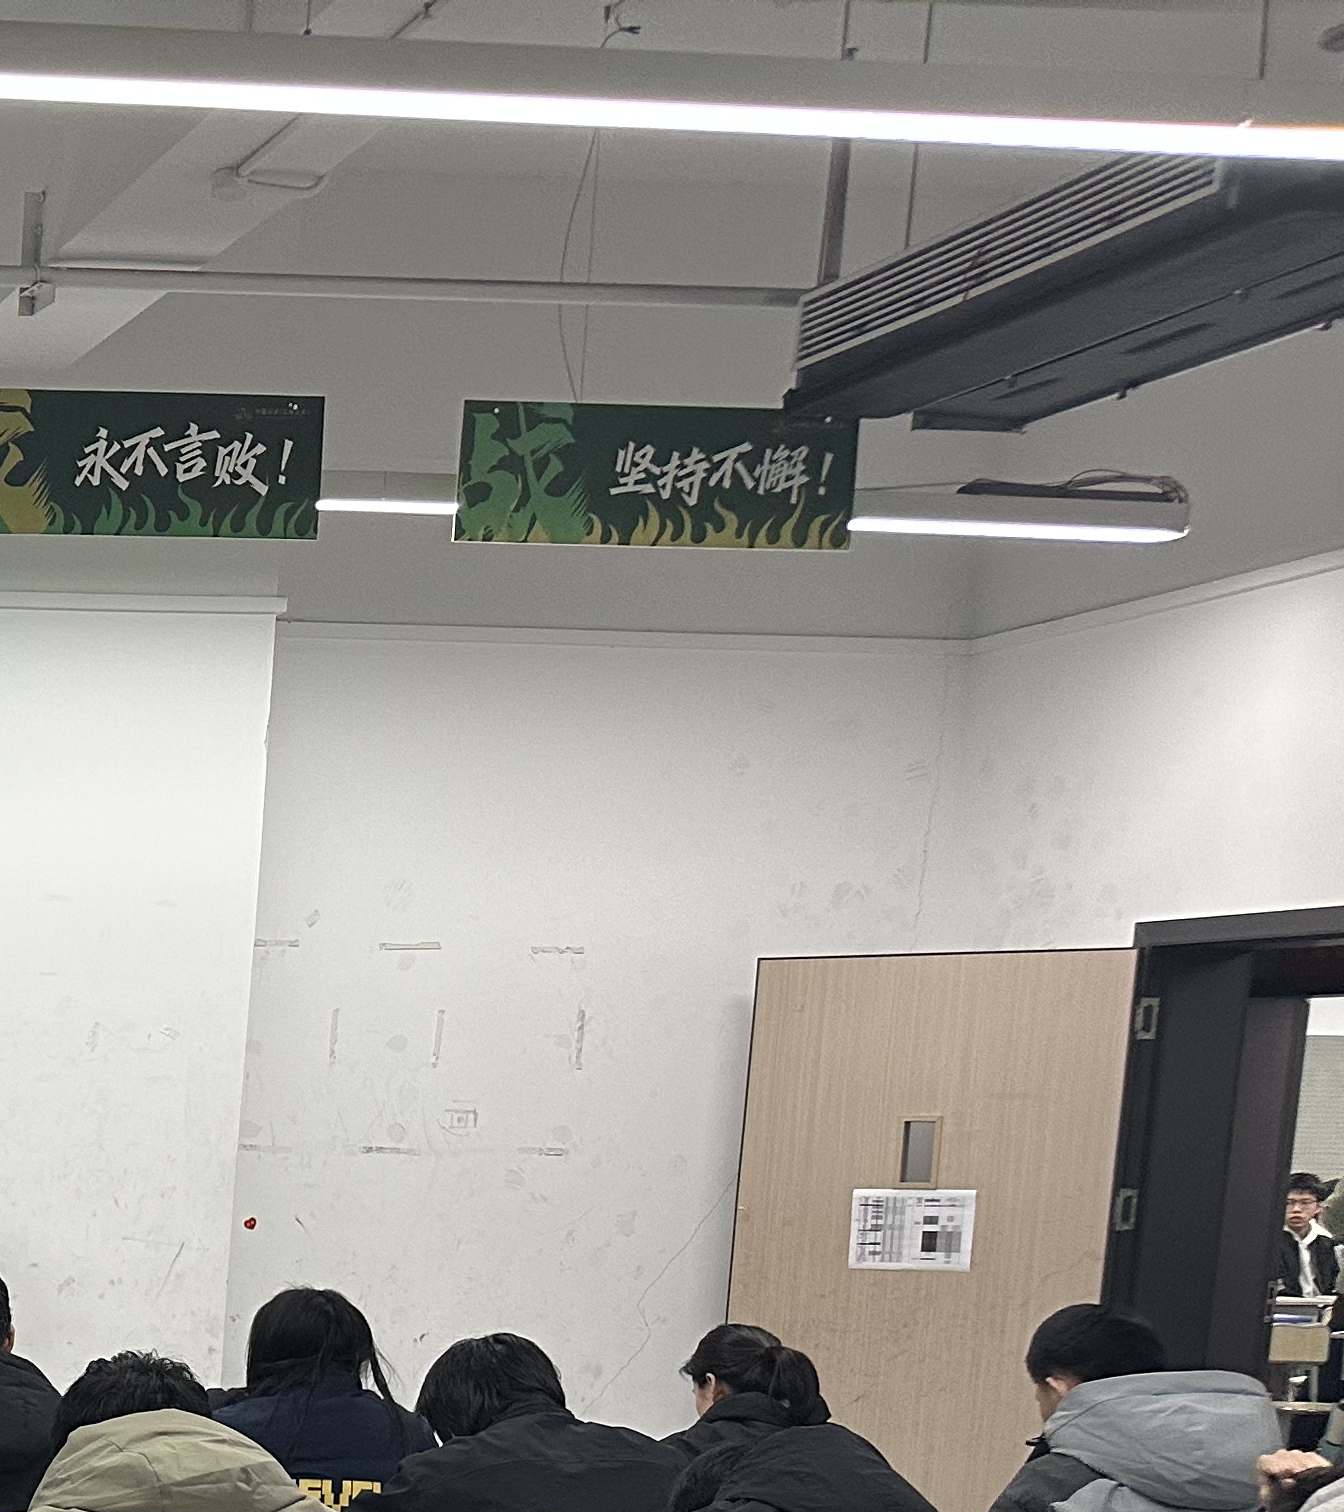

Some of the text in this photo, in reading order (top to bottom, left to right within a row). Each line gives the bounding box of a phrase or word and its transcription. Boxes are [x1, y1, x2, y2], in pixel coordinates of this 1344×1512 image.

[74, 422, 294, 492] 永不言败！
[610, 441, 833, 506] 坚持不懈！
